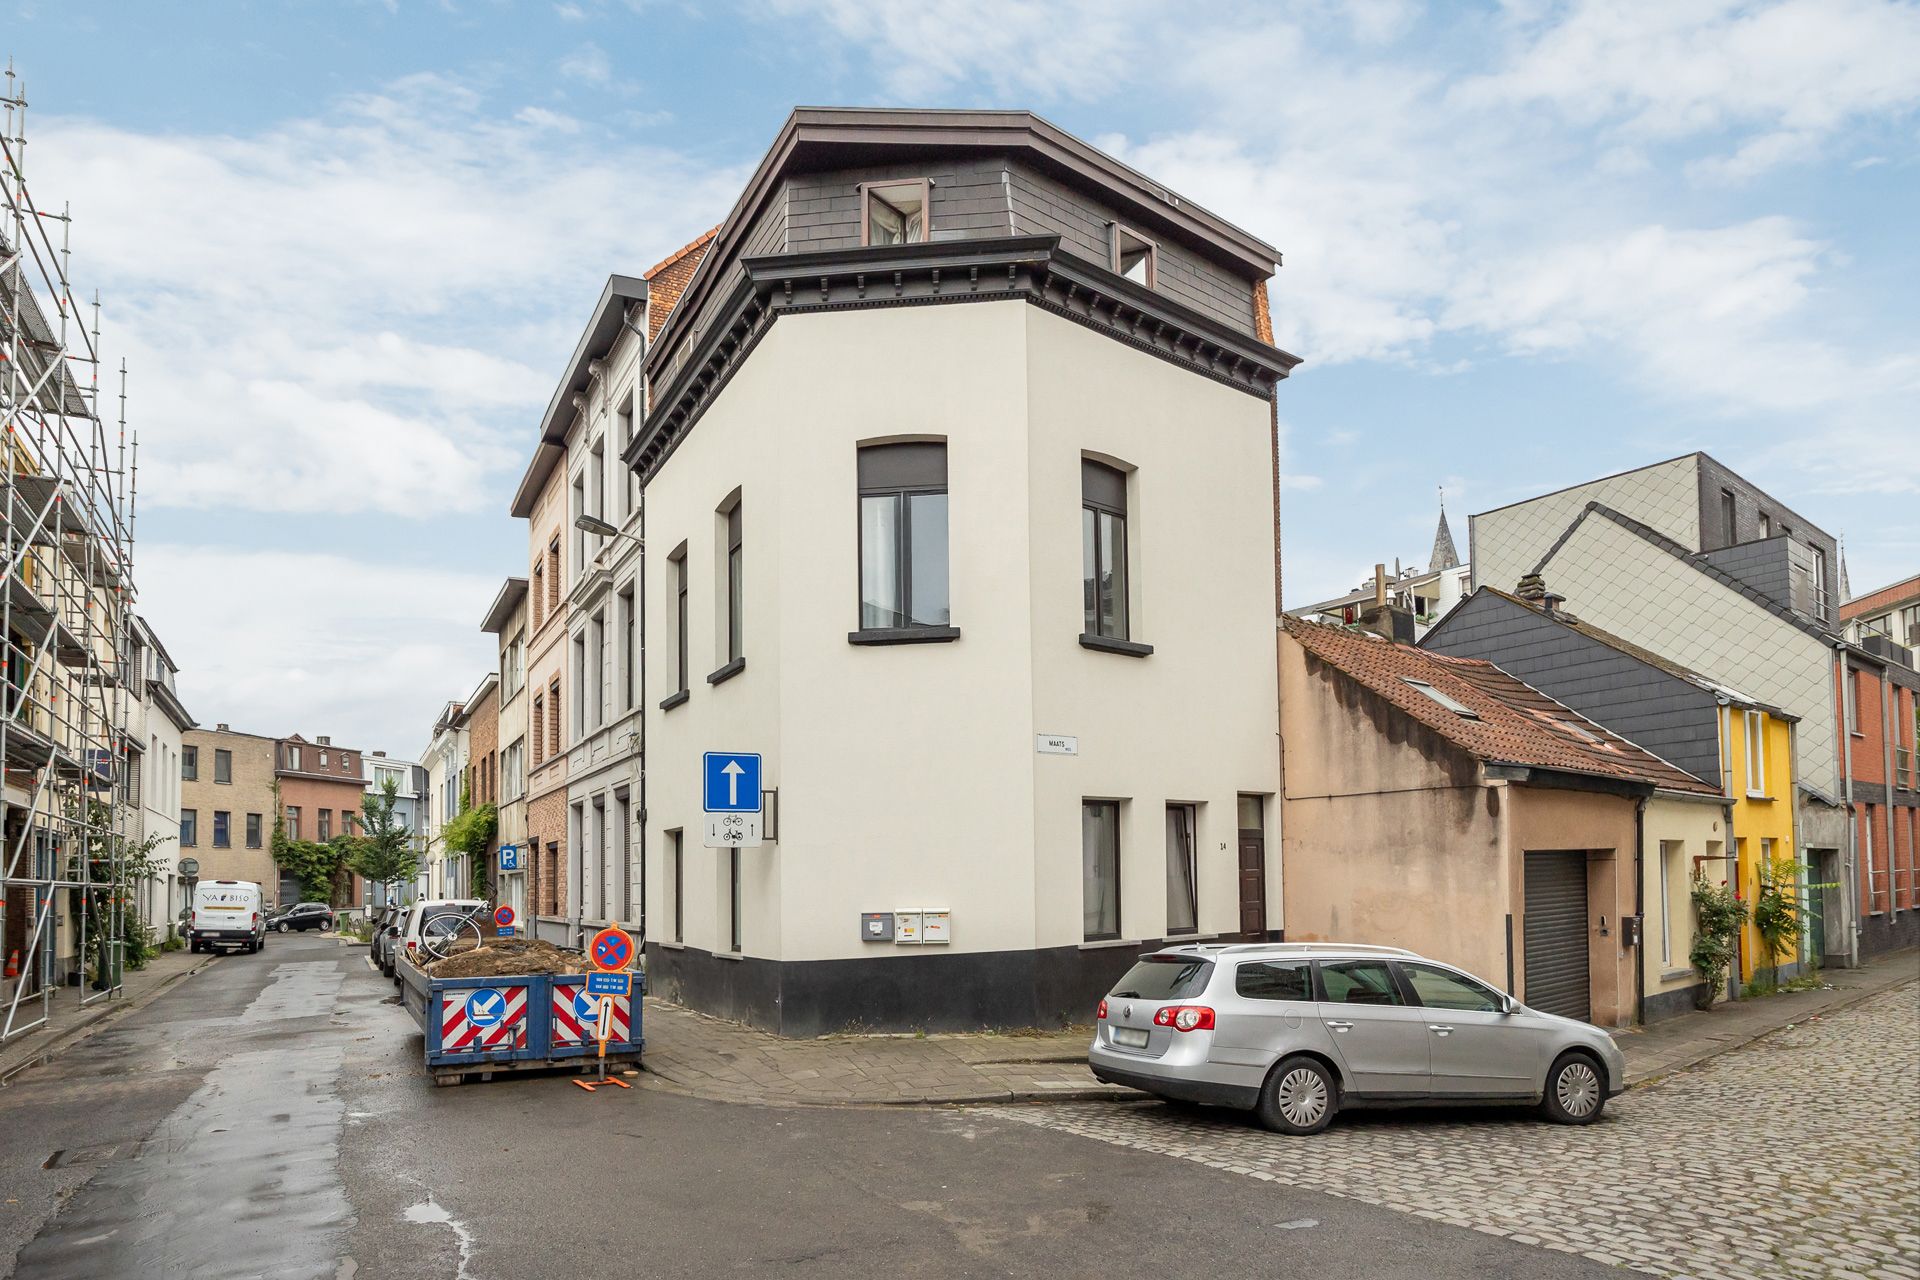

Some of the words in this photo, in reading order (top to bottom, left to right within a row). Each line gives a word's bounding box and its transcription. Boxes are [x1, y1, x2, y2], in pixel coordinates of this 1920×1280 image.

[1048, 740, 1065, 748] MAATS
[1220, 842, 1226, 850] 14
[502, 849, 514, 865] P
